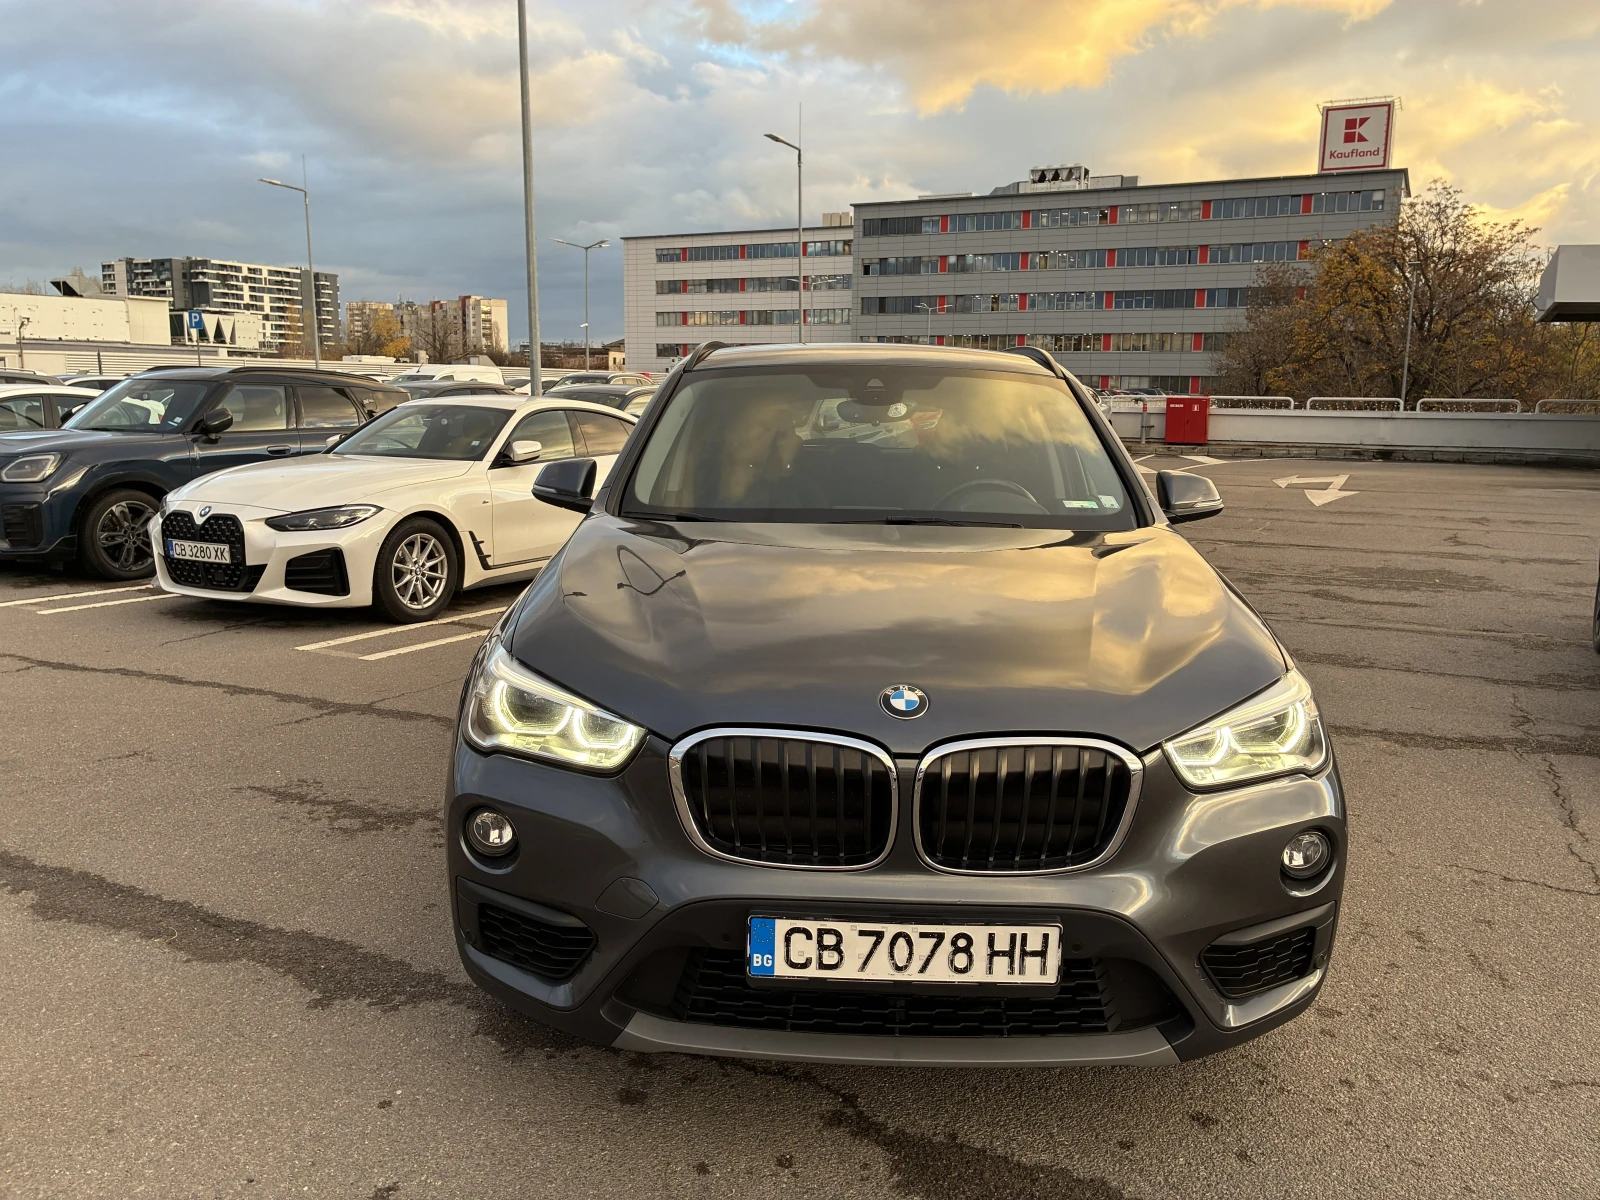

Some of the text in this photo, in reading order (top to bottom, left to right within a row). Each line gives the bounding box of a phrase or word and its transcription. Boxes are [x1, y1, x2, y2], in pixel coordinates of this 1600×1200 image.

[1329, 147, 1380, 159] Kaufland
[191, 313, 200, 327] P
[174, 543, 228, 561] CB 3280 XK
[884, 684, 925, 696] BMW
[752, 926, 1050, 976] BG CB 7078 HH
